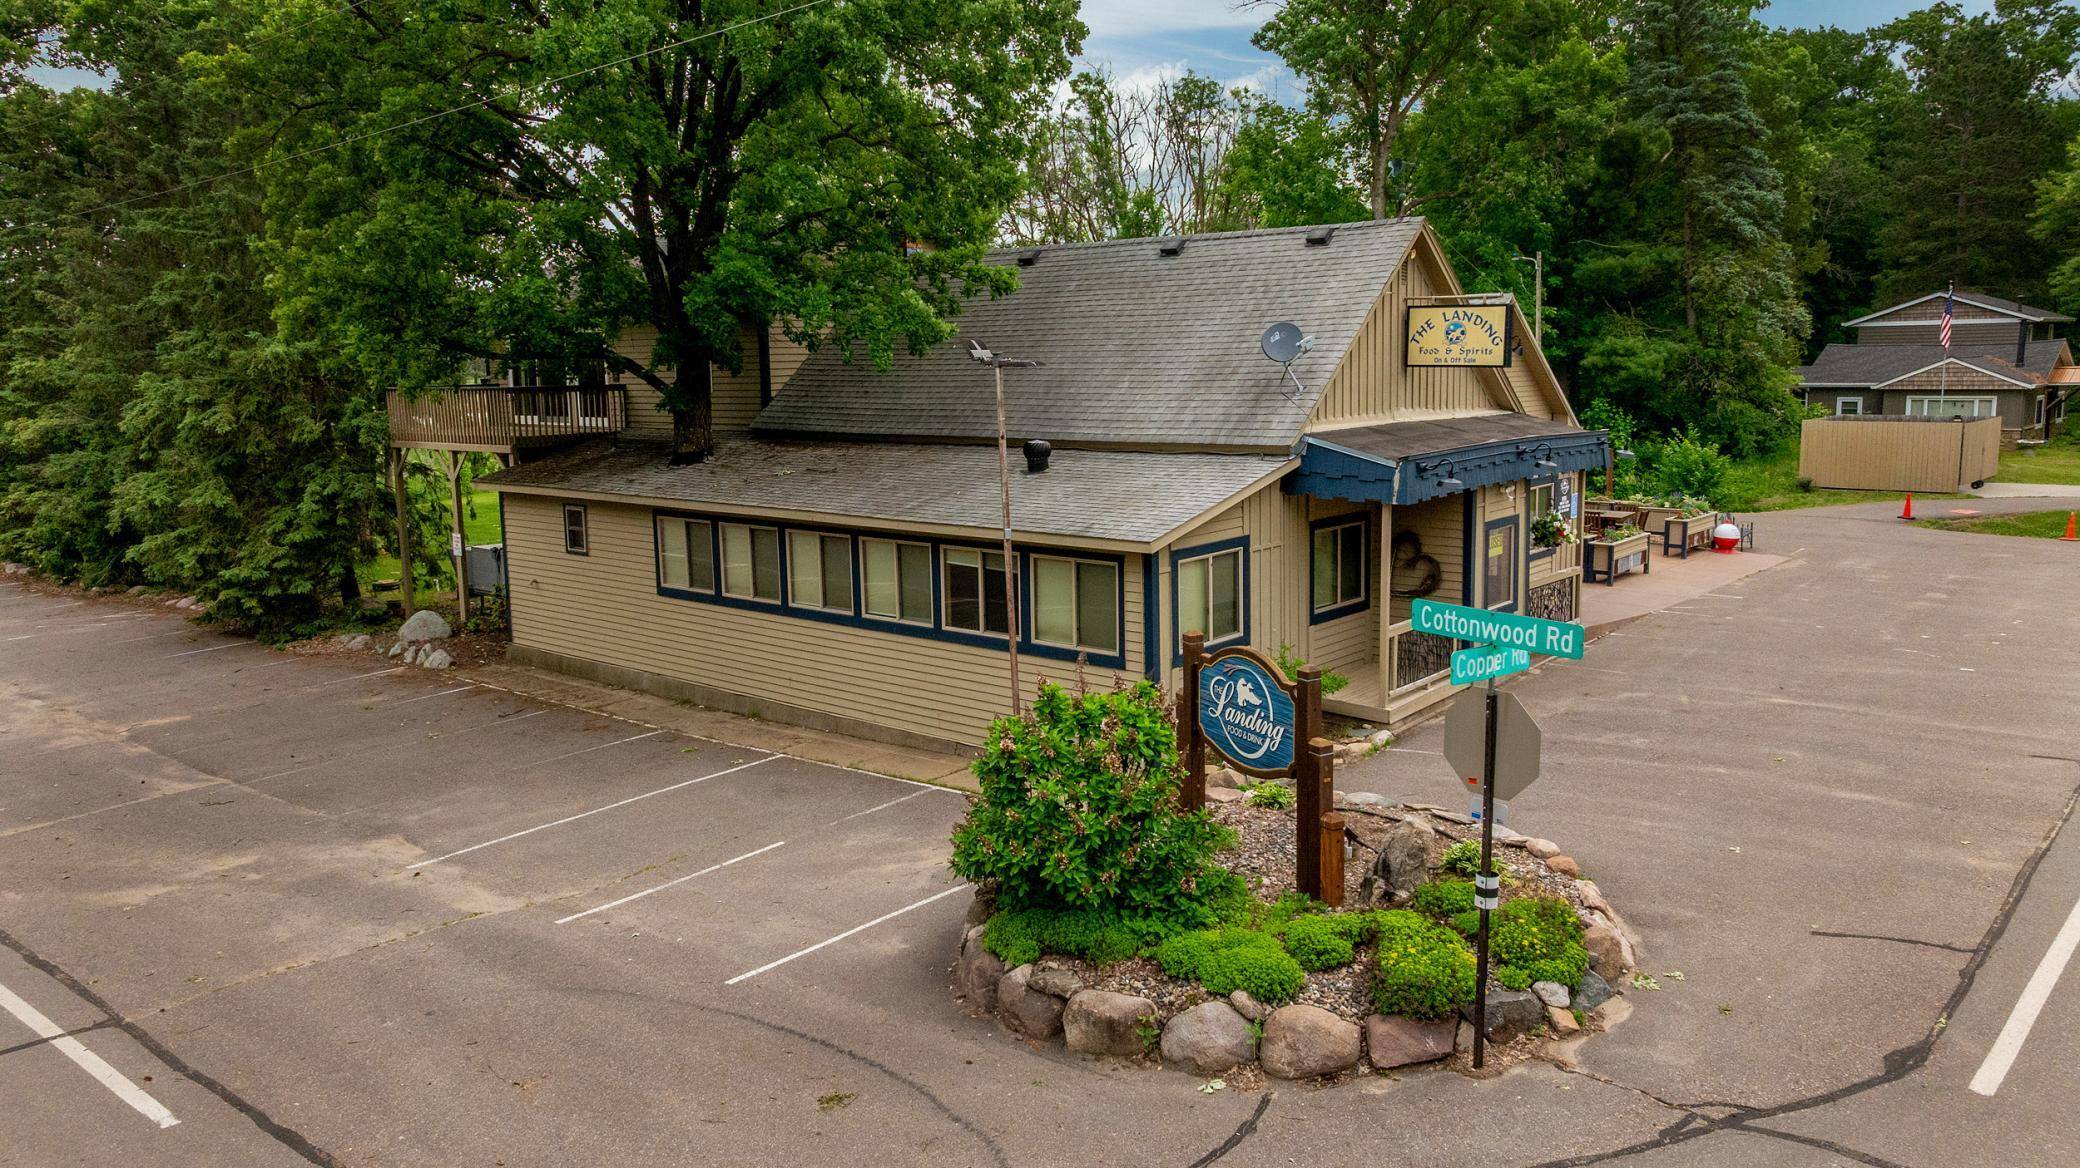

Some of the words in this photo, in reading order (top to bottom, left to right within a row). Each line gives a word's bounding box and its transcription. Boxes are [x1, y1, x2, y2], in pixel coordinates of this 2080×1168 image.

[1410, 318, 1435, 345] THE
[1442, 310, 1503, 346] LANDING
[1419, 347, 1440, 355] Food
[1445, 347, 1453, 355] &
[1459, 347, 1493, 357] Spirits
[1420, 605, 1538, 648] Cottonwood
[1546, 626, 1574, 654] Rd
[1456, 651, 1508, 678] Copper
[1208, 676, 1285, 751] Landing
[1227, 725, 1243, 738] FOOD
[1242, 731, 1247, 739] &
[1247, 733, 1265, 746] DRINK
